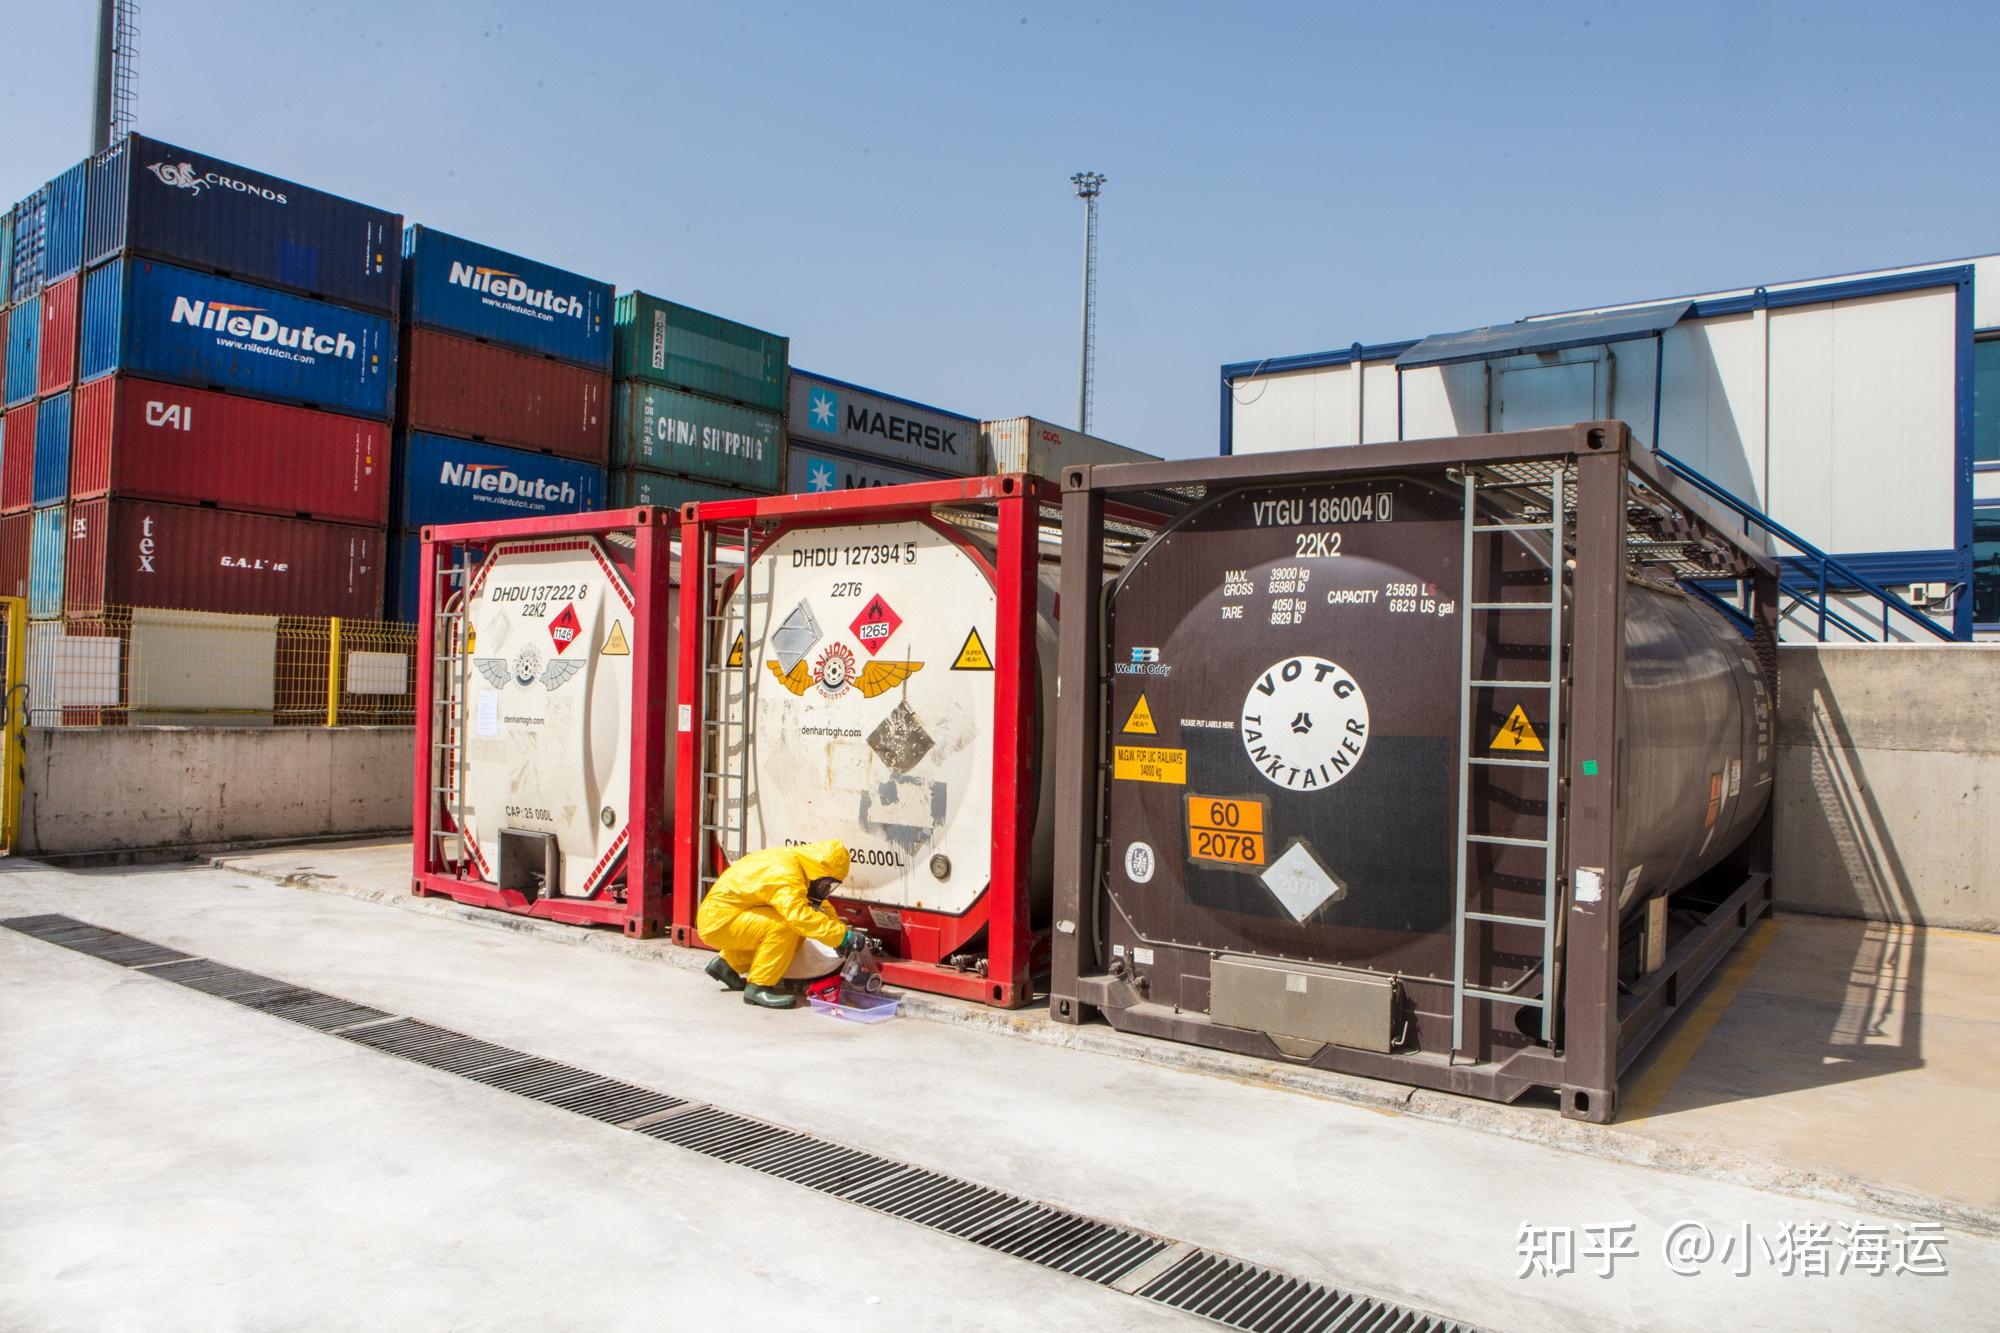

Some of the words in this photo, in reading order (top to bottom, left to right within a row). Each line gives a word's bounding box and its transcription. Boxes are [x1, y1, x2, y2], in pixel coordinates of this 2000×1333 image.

[205, 171, 288, 205] CRONOS
[449, 261, 583, 319] NileDutch
[482, 296, 554, 322] www.niledutch.com
[171, 296, 356, 359] NileDutch
[216, 337, 315, 364] www.niledutch.com
[146, 401, 192, 431] CAI
[657, 417, 697, 447] CHINA
[847, 405, 957, 455] MAERSK
[440, 461, 575, 504] NileDutch
[473, 494, 545, 511] www.niledutch.com
[1253, 499, 1303, 526] VTGU
[1309, 495, 1373, 523] 186004
[1379, 494, 1389, 520] 0
[137, 515, 155, 572] tex
[1295, 532, 1341, 558] 22K2
[793, 547, 838, 568] DHDU
[843, 544, 900, 566] 127394
[906, 544, 915, 563] 5
[1225, 570, 1247, 583] MAX.
[1270, 568, 1297, 580] 39000
[1299, 567, 1310, 581] kg
[492, 586, 529, 602] DHDU
[532, 585, 575, 601] 137222
[579, 584, 587, 600] 8
[830, 582, 862, 598] 22T6
[1223, 583, 1254, 596] GROSS
[1268, 581, 1296, 593] 85980
[1297, 580, 1305, 592] lb
[1386, 583, 1418, 597] 25850
[1272, 599, 1293, 611] 4050
[1295, 598, 1306, 614] kg
[1327, 590, 1378, 604] CAPACITY
[522, 602, 546, 618] 22K2
[1222, 606, 1243, 619] TARE
[1389, 599, 1416, 612] 6829
[1420, 600, 1435, 613] US
[1438, 600, 1455, 617] gal
[1271, 612, 1291, 625] 8929
[1294, 611, 1302, 624] lb
[555, 628, 573, 641] 1146
[861, 624, 888, 638] 1265
[871, 640, 877, 649] 3
[814, 653, 828, 684] DEN
[1257, 660, 1356, 699] VOTG
[801, 725, 862, 739] denhartogh.com
[1181, 719, 1196, 727] PLEASE
[1197, 720, 1205, 728] PUT
[1206, 720, 1221, 729] LABELS
[1222, 721, 1234, 729] HERE
[1137, 750, 1147, 762] FOR
[1157, 751, 1183, 764] RAILWAYS
[1245, 715, 1365, 788] TANKTAINER
[1156, 766, 1162, 780] kg
[524, 808, 533, 819] 25
[1211, 801, 1240, 827] 60
[1198, 832, 1256, 861] 2078
[1279, 874, 1319, 897] 2078
